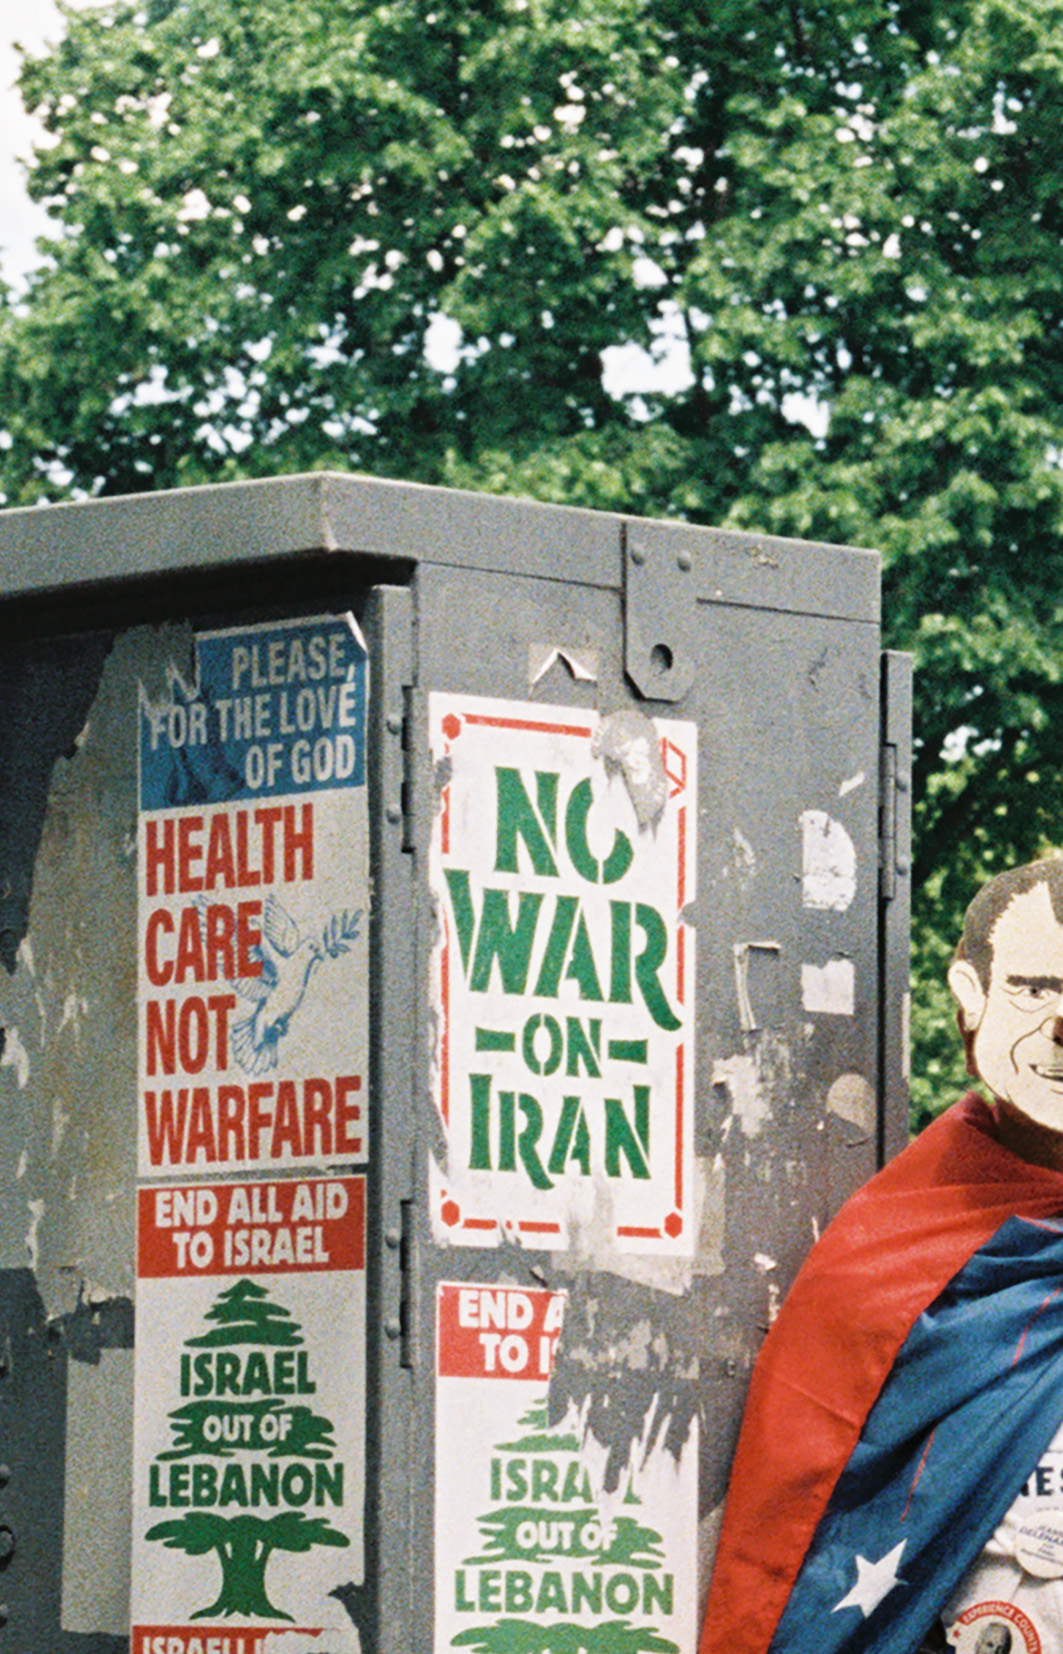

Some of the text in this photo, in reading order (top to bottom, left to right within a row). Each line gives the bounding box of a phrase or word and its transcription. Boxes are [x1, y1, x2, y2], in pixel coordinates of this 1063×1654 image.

[232, 633, 355, 690] PLEASE,
[150, 682, 357, 750] FOR THE LOVE
[246, 734, 356, 790] OF GOD
[145, 803, 314, 897] HEALTH
[494, 766, 635, 885] NO
[145, 901, 264, 987] CARE
[443, 867, 683, 1032] WAR
[146, 994, 236, 1076] NOT
[144, 1075, 362, 1166] WARFARE
[468, 1073, 652, 1191] IRAN
[154, 1183, 349, 1228] END ALL AID
[172, 1227, 330, 1269] TO ISRAEL
[458, 1290, 534, 1330] END
[180, 1351, 317, 1396] ISRAEL
[479, 1333, 529, 1373] TO
[203, 1414, 293, 1442] OUT OF
[149, 1463, 344, 1507] LEBANON
[490, 1458, 642, 1504] ISRA
[515, 1521, 618, 1551] OUT OF
[454, 1569, 675, 1616] LEBANON
